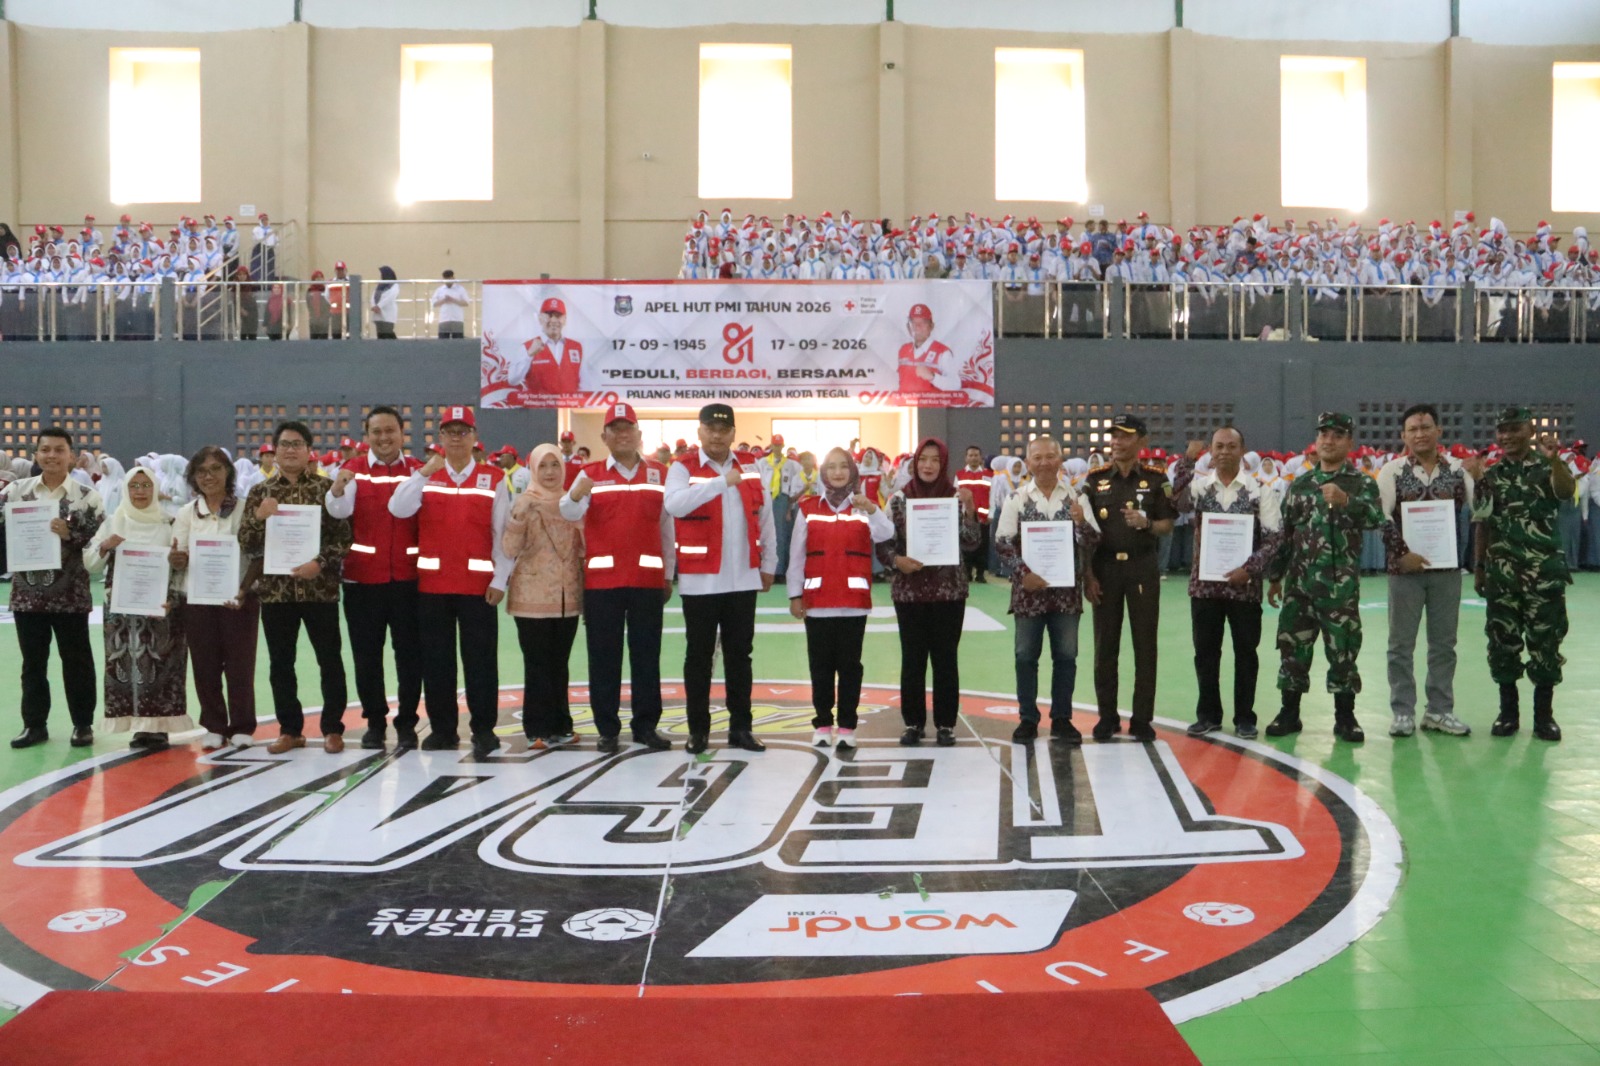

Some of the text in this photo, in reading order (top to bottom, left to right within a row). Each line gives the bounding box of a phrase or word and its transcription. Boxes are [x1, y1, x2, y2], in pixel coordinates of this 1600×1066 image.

[644, 302, 832, 313] APEL HUT PMI TAHUN 2026
[612, 339, 628, 350] 17
[640, 339, 658, 350] 09
[674, 339, 706, 350] 1945
[771, 339, 785, 350] 17
[799, 339, 817, 350] 09
[832, 339, 867, 350] 2026
[602, 368, 875, 380] "PEDULI, BERBAGI, BERSAMA"
[626, 389, 850, 399] PALANG MERAH INDONESIA KOTA TEGAL
[372, 908, 549, 923] SERIES
[366, 922, 544, 937] FUTSAL
[768, 912, 1018, 938] wondr
